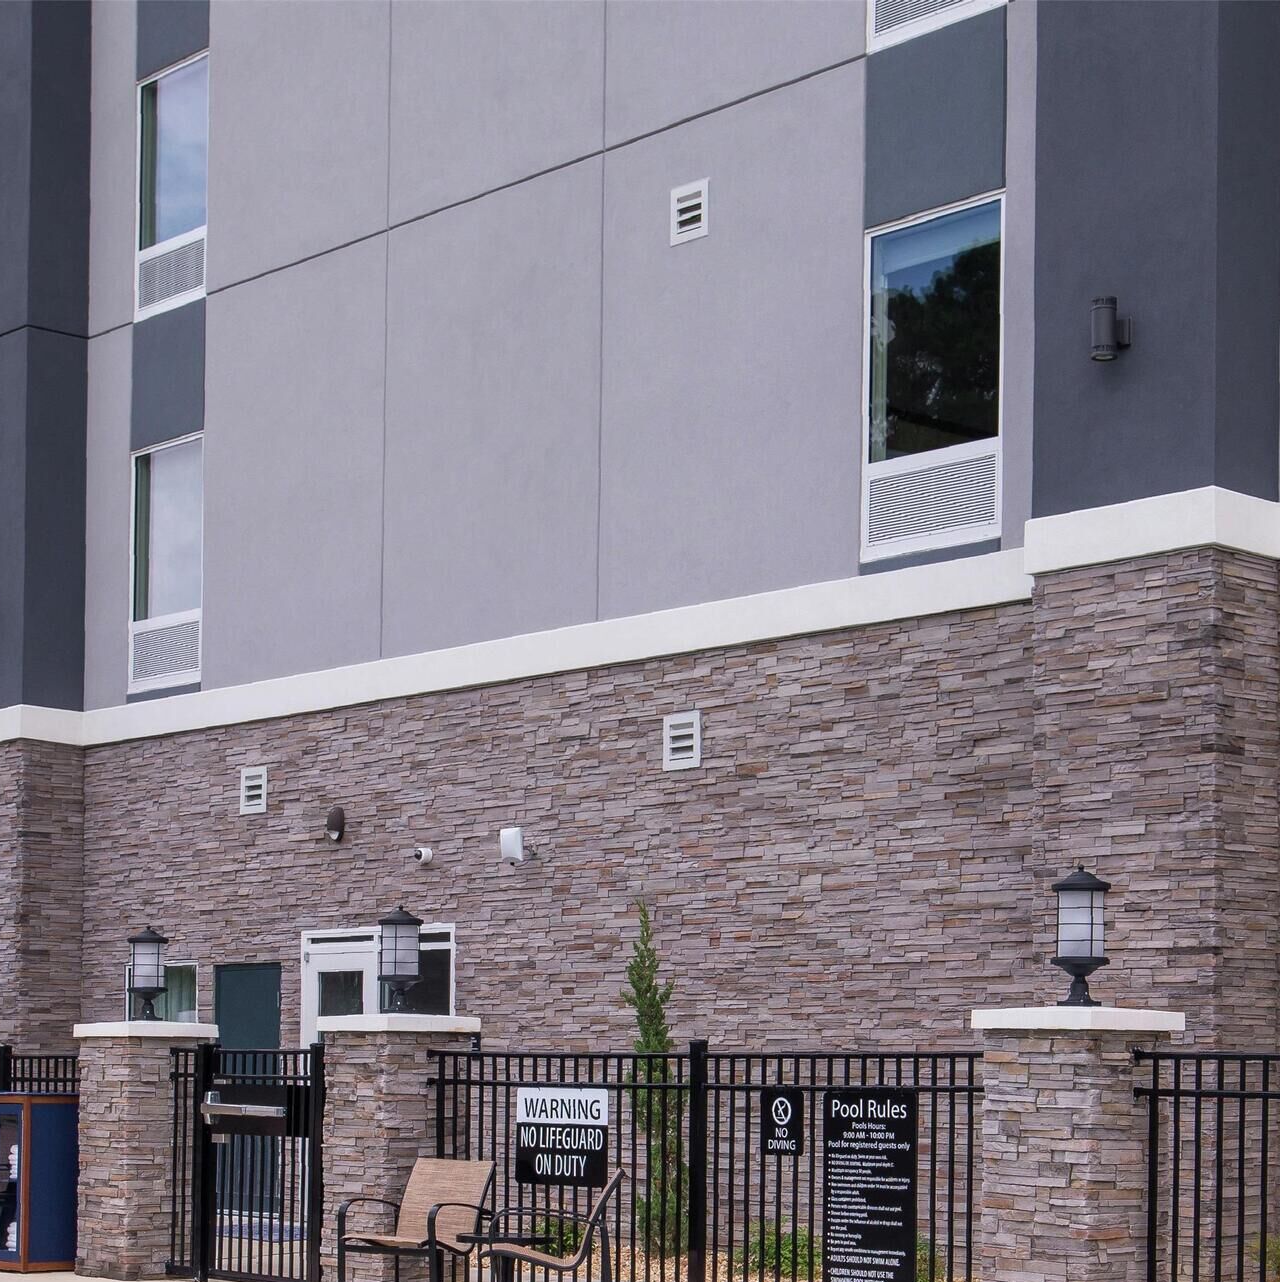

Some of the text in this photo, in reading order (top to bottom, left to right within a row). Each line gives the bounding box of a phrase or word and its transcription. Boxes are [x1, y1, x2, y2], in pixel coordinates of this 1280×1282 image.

[524, 1098, 600, 1120] WARNING
[832, 1098, 907, 1119] Pool Rules
[520, 1126, 603, 1150] NO LIFEGUARD
[775, 1127, 788, 1138] NO
[767, 1139, 796, 1150] DIVING
[535, 1153, 587, 1177] ON DUTY
